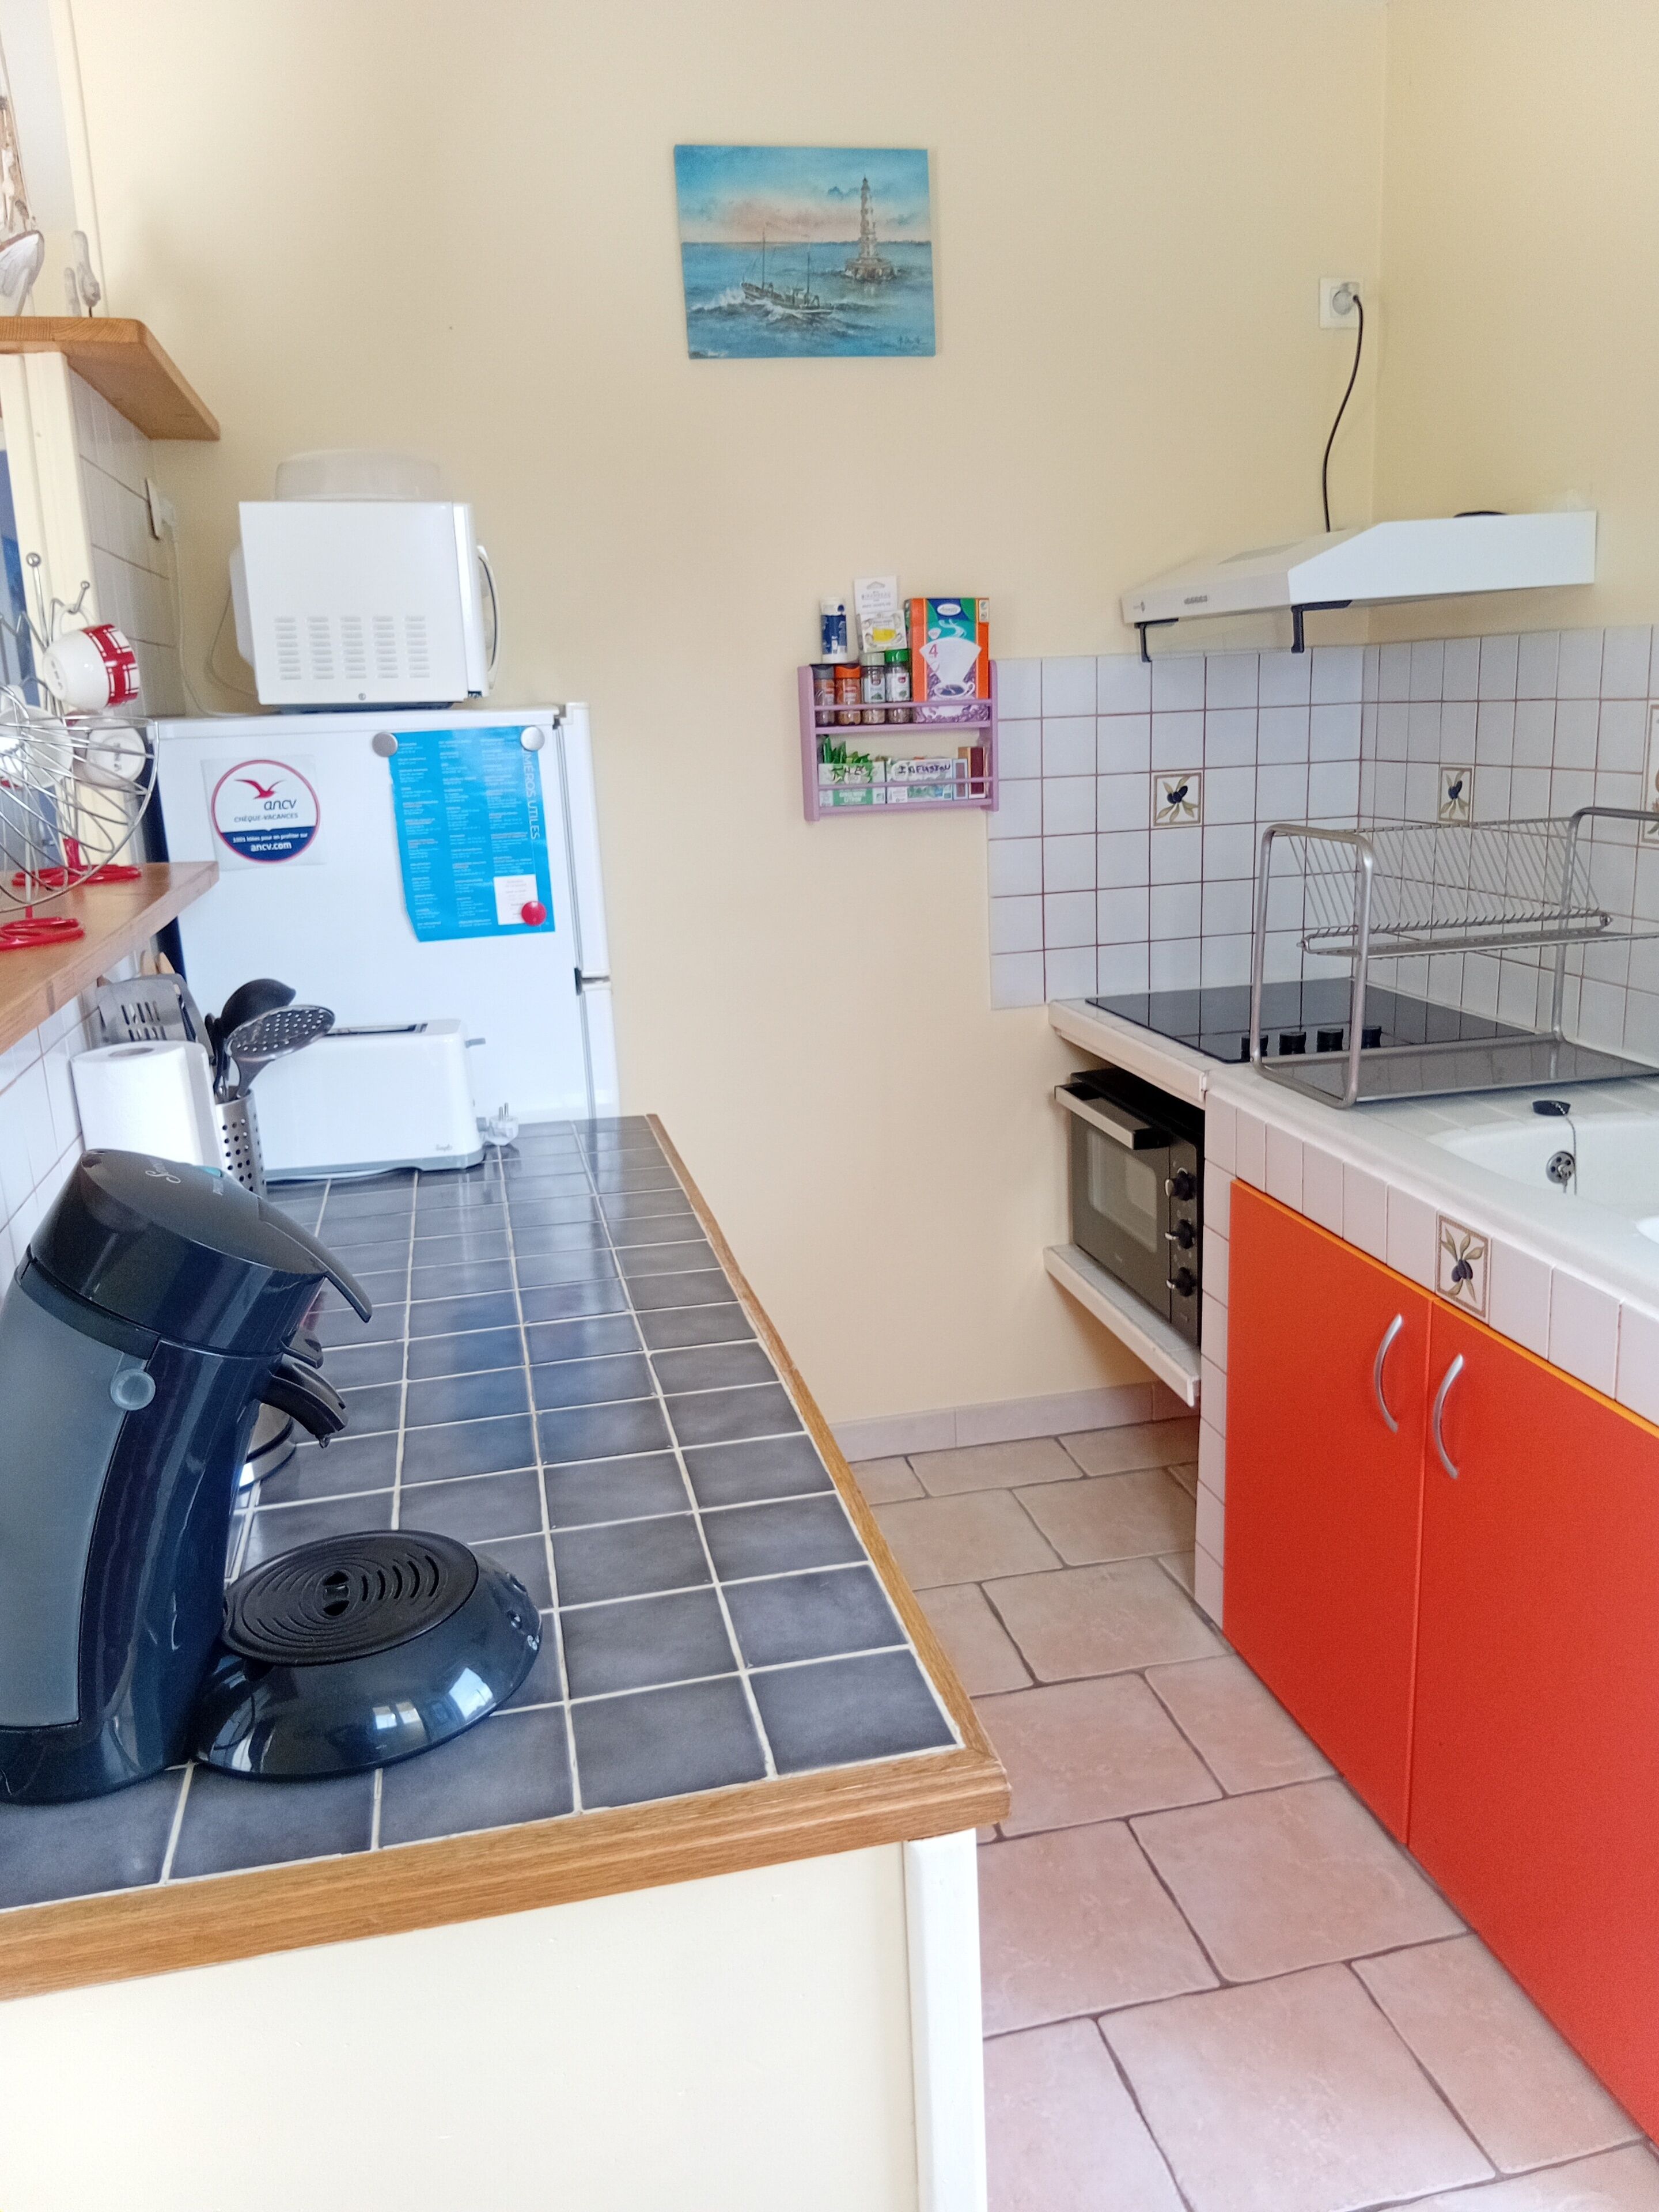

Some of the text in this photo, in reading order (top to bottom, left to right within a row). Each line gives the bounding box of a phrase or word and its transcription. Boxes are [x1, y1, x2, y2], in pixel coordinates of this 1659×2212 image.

[929, 644, 938, 658] 4
[264, 800, 297, 810] ancv
[528, 800, 540, 840] UTILES
[251, 842, 291, 852] ancv.com
